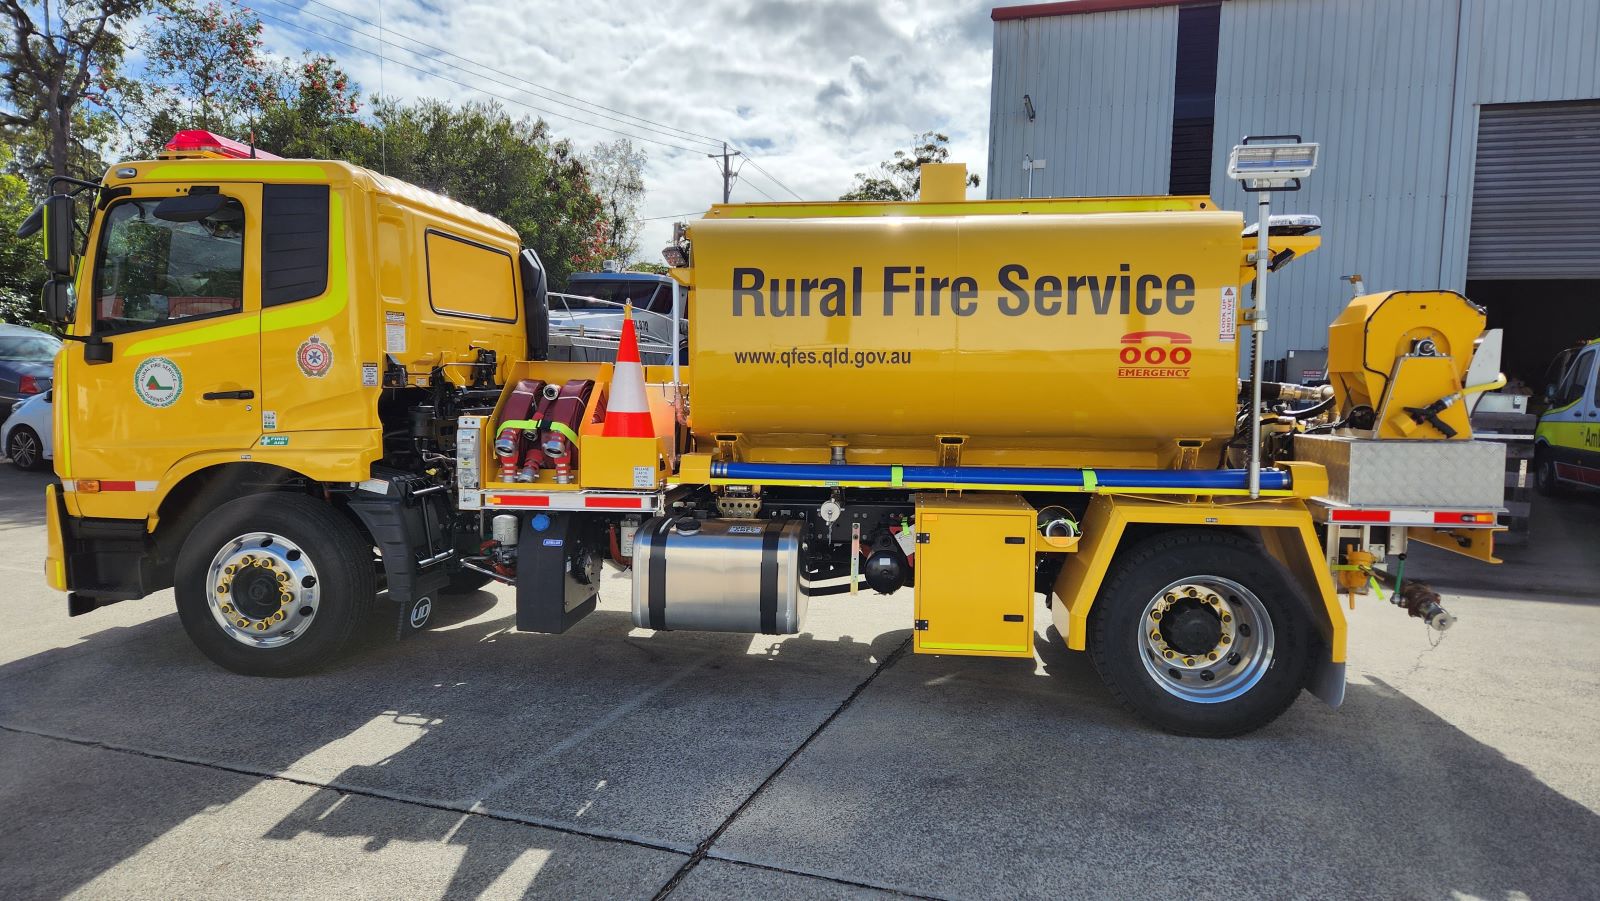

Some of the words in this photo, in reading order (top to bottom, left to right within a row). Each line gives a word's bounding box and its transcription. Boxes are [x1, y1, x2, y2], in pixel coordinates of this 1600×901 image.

[732, 266, 862, 317] Rural
[882, 266, 978, 317] Fire
[997, 263, 1196, 316] Service
[1222, 298, 1227, 309] UP
[734, 347, 912, 369] www.qfes.qld.gov.au
[1118, 368, 1190, 377] EMERGENCY
[1585, 427, 1600, 448] Am
